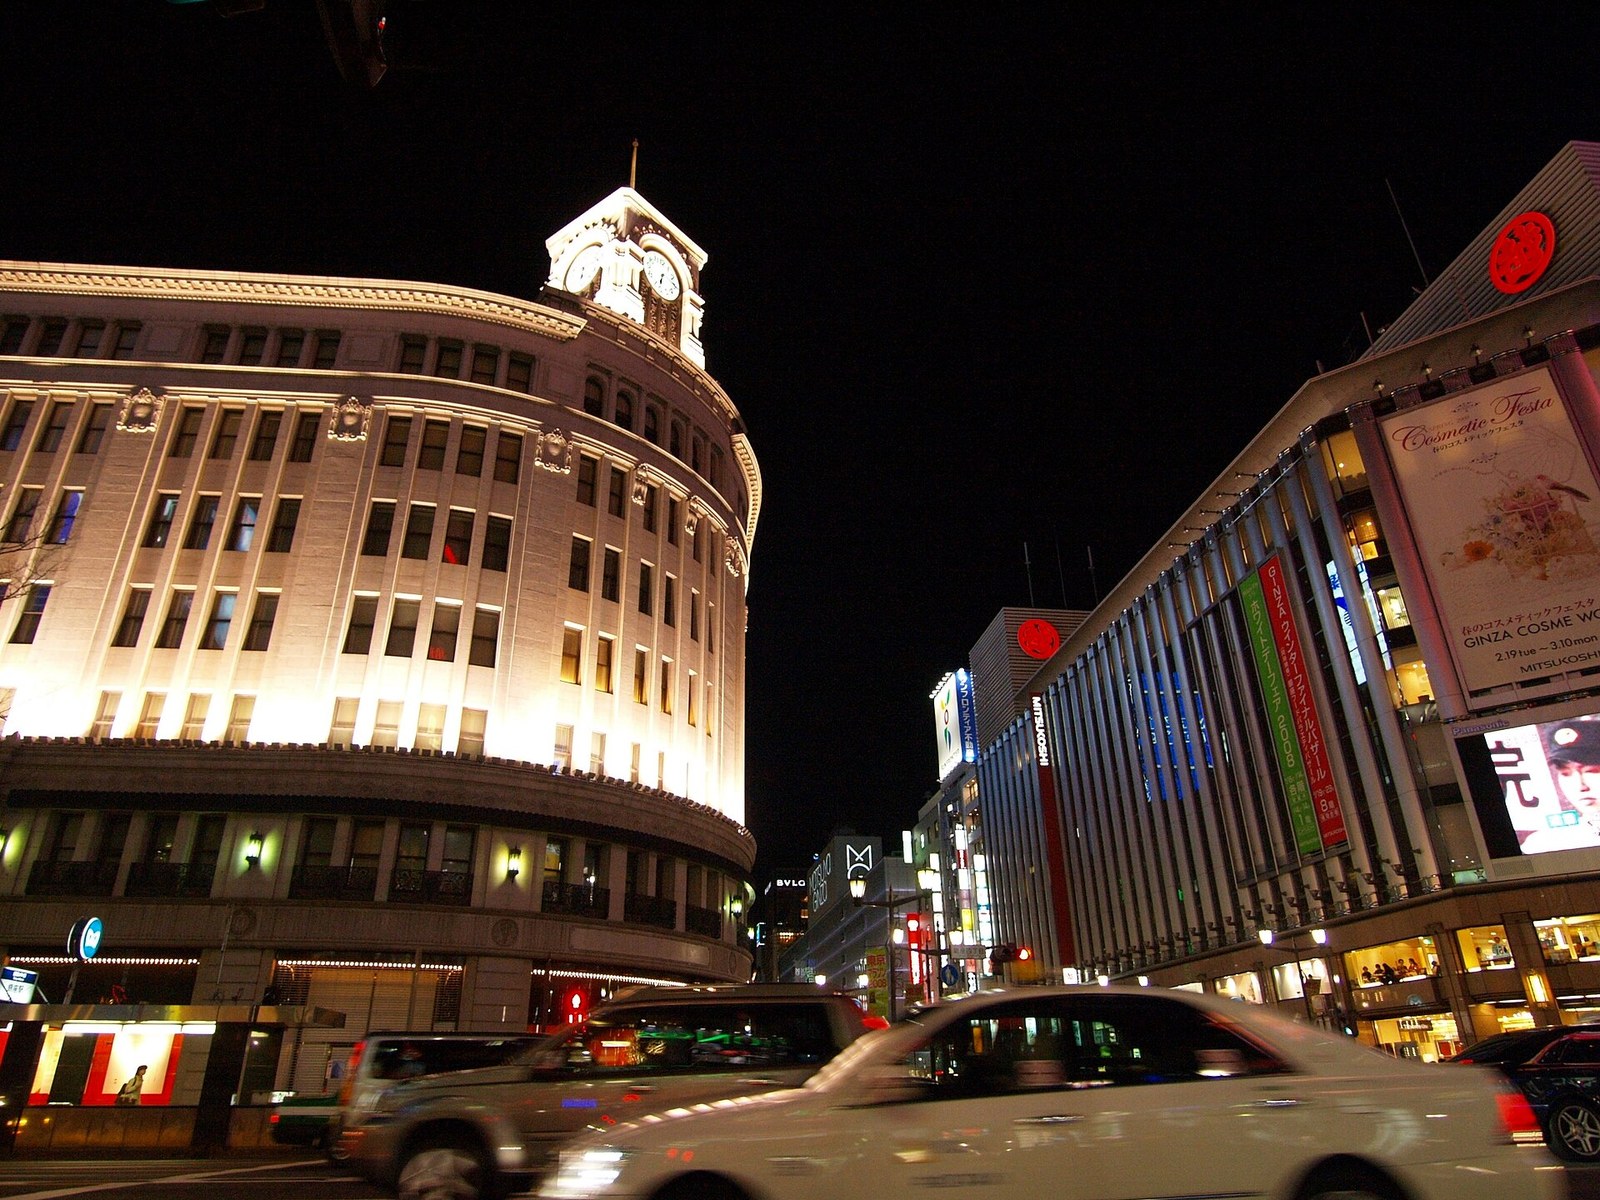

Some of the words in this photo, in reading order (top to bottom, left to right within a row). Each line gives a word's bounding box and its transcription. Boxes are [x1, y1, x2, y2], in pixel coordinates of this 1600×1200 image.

[1392, 417, 1488, 451] Cosmetic
[1491, 386, 1554, 424] Festa
[1268, 566, 1287, 619] GINZA
[1464, 630, 1513, 648] GINZA
[1517, 616, 1573, 637] COSME
[1032, 696, 1049, 766] MITSUKOSHI
[1277, 715, 1295, 768] 2008
[1452, 719, 1509, 736] Panasonic
